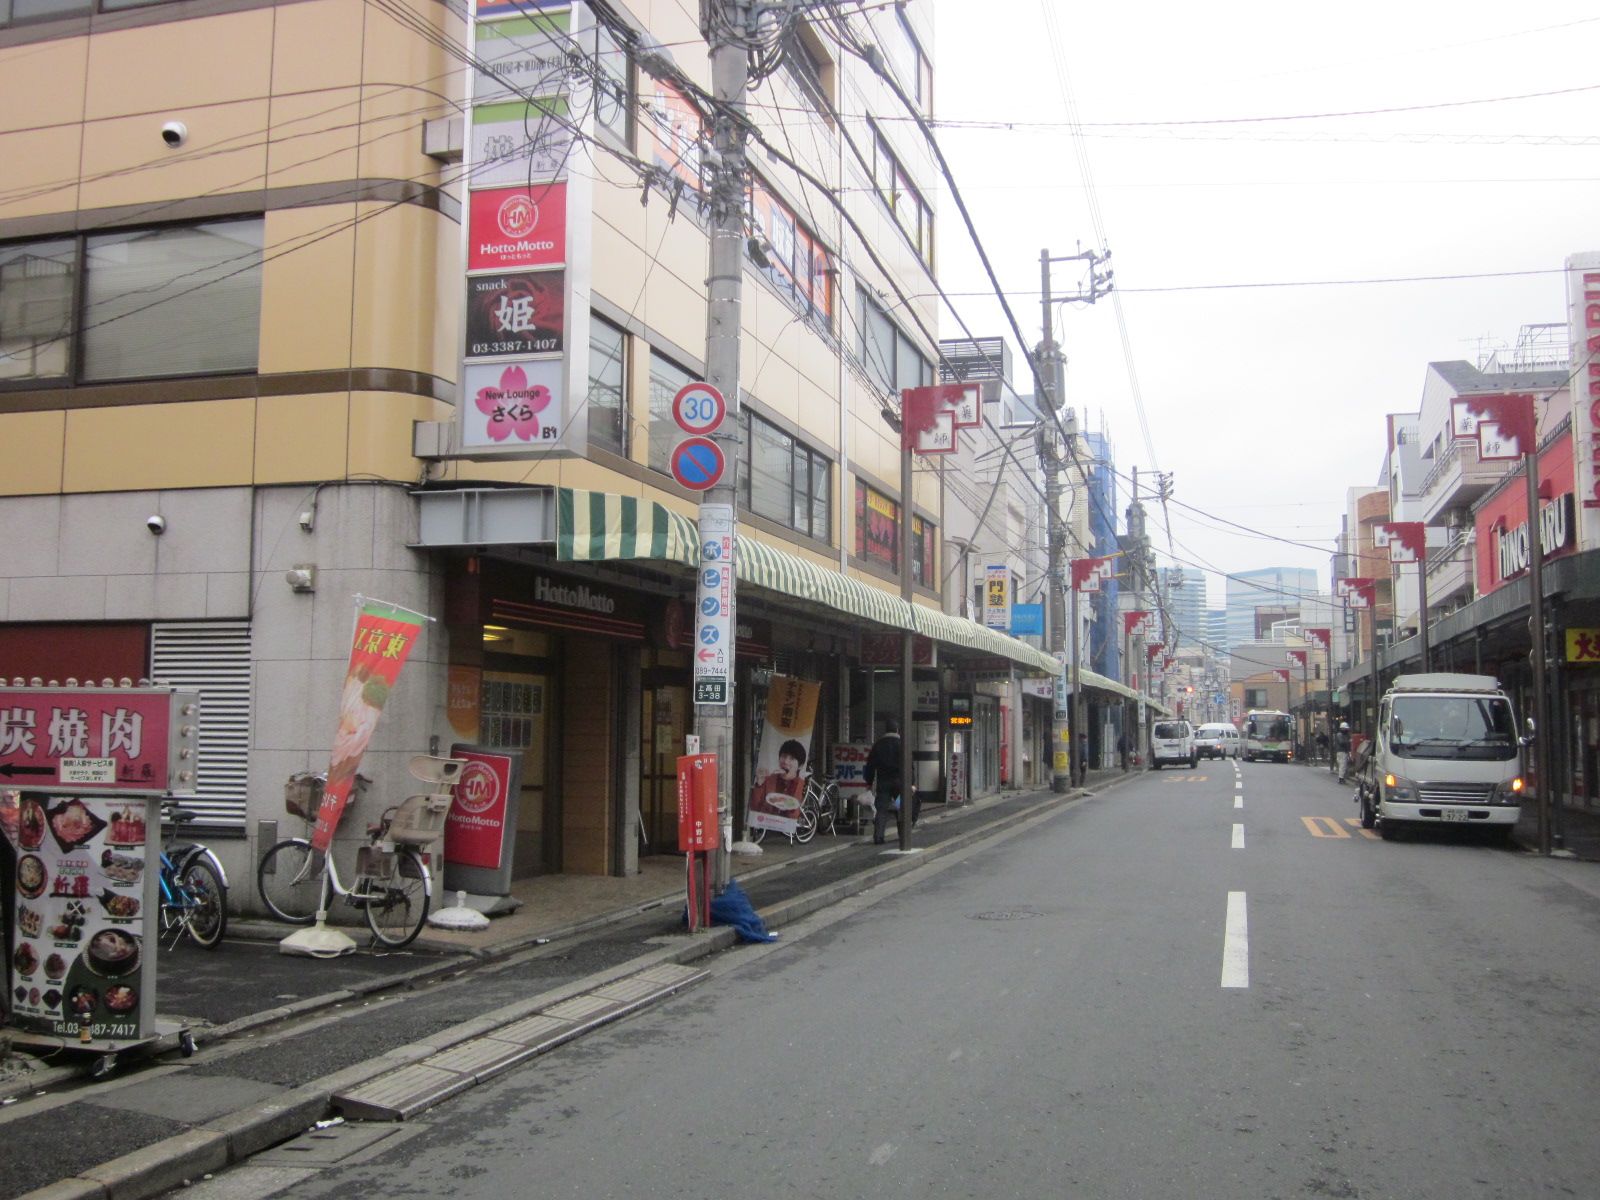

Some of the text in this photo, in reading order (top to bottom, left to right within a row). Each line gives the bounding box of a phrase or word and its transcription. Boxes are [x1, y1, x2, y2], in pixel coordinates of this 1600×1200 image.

[476, 279, 508, 291] snack
[495, 295, 536, 333] 姫
[473, 339, 557, 354] 03-3387-1407
[485, 390, 540, 400] New Lounge
[492, 404, 533, 422] さくら
[684, 397, 714, 421] 30
[717, 649, 723, 663] 入口
[698, 684, 721, 692] 上高田
[698, 692, 721, 700] 3-38
